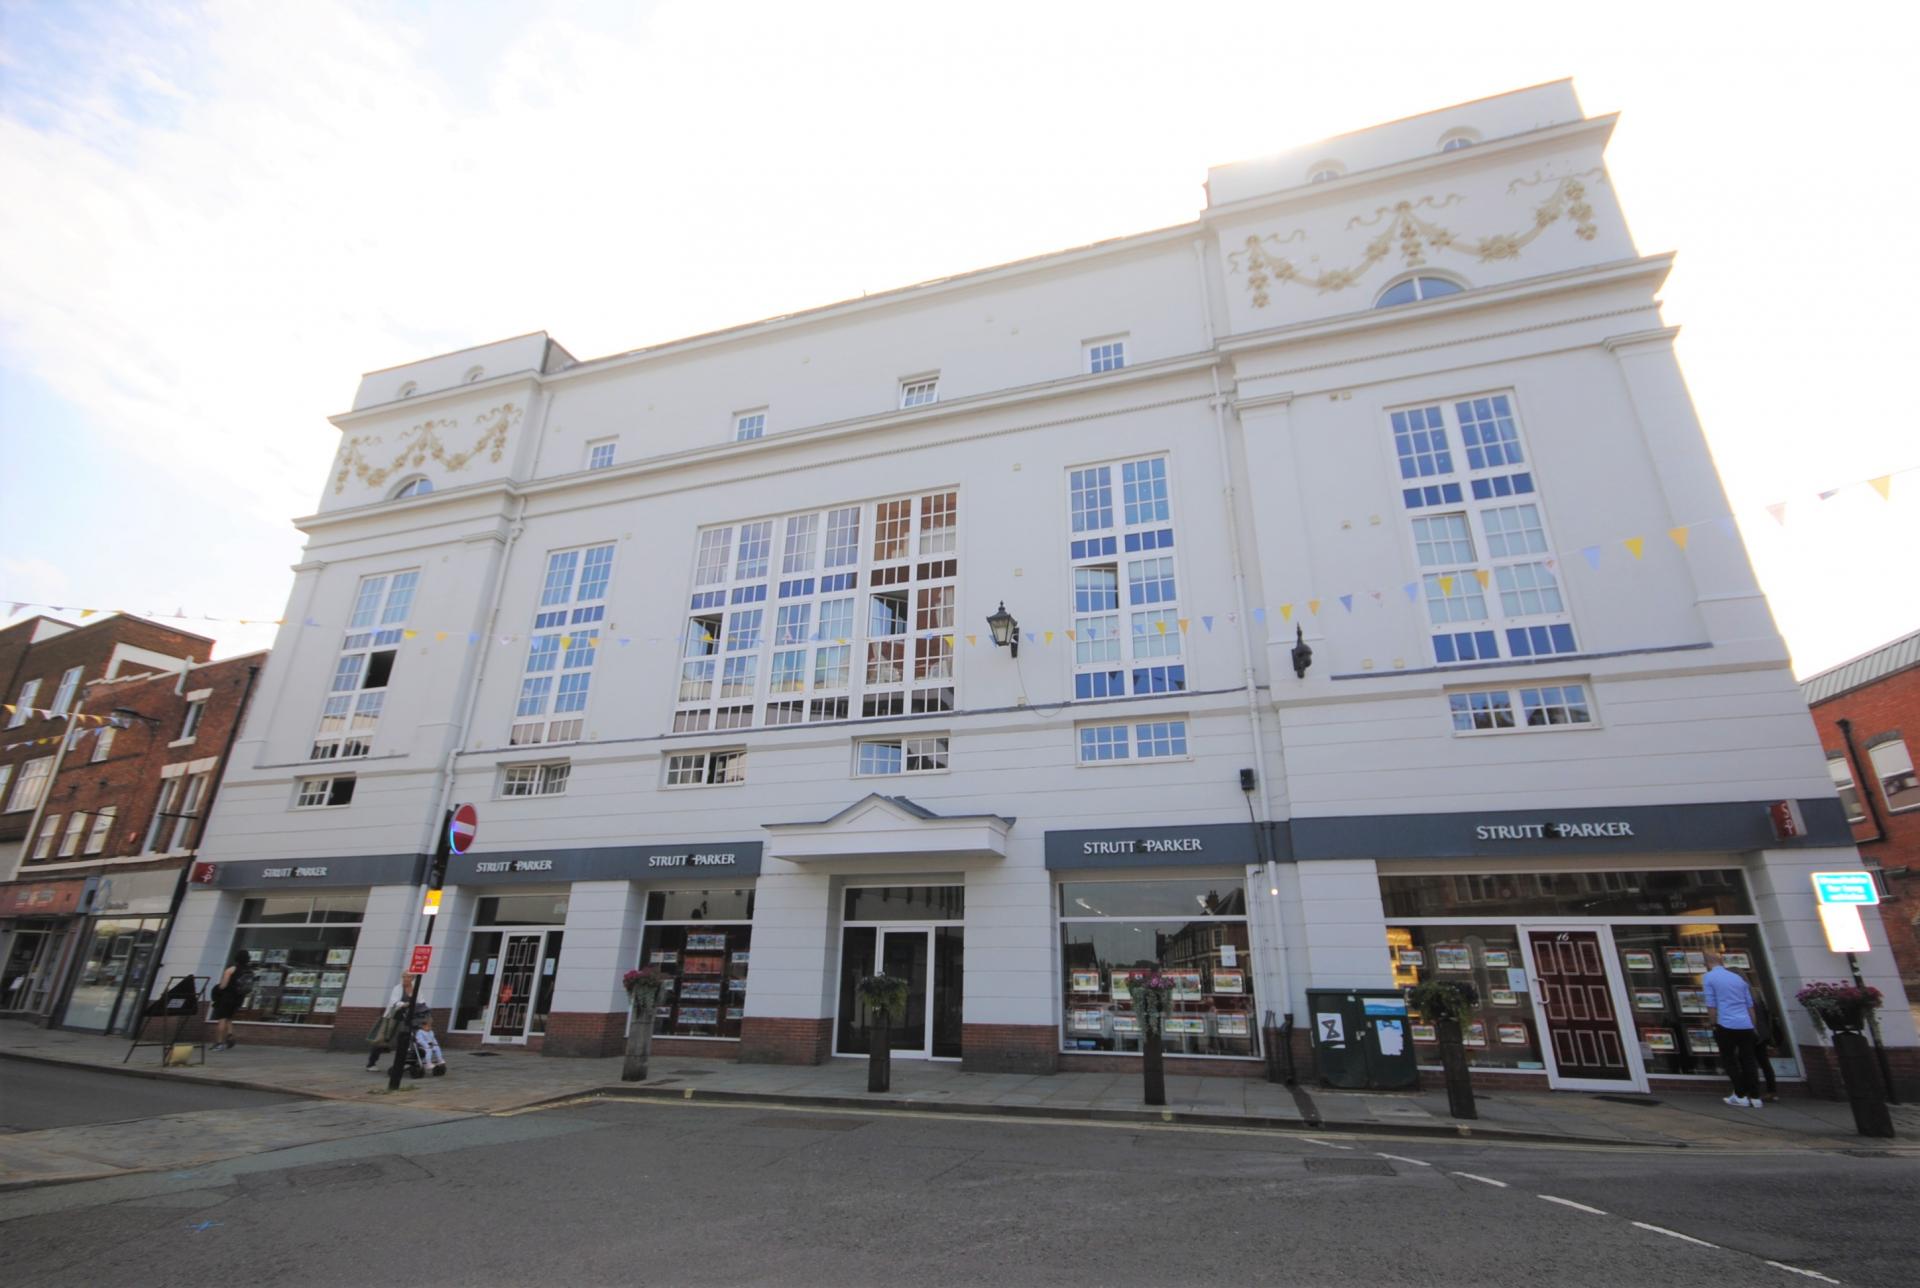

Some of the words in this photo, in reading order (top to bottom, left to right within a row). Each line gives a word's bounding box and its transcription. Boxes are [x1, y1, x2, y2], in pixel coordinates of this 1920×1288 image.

[1476, 824, 1544, 840] STRUTT
[1559, 821, 1635, 838] PARKER
[1083, 840, 1136, 855] STRUTT
[1145, 838, 1203, 853] PARKER
[475, 861, 512, 873] STRUTT
[514, 859, 553, 871] PARKER
[648, 855, 688, 867] STRUTT
[694, 853, 736, 866] PARKER
